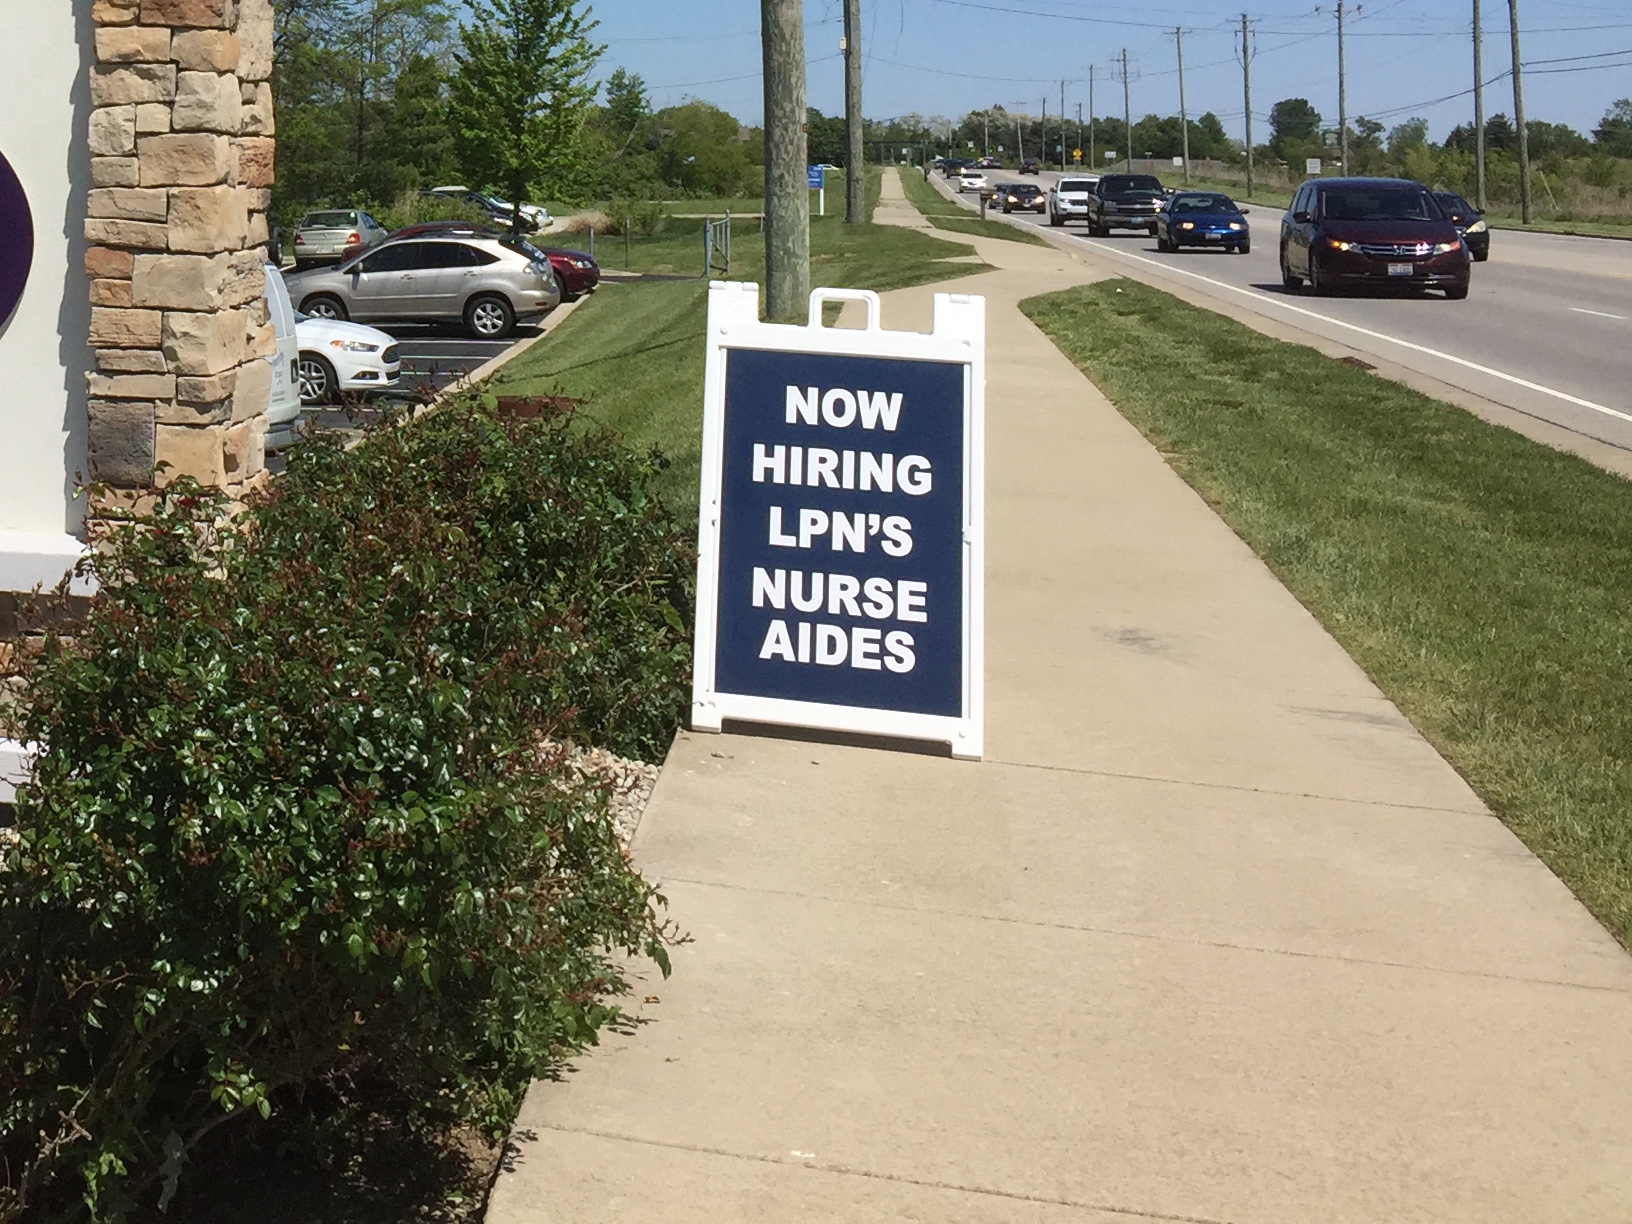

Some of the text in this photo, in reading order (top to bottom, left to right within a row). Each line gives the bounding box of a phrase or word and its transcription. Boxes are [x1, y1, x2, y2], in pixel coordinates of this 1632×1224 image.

[785, 385, 904, 431] NOW
[751, 442, 933, 496] HIRING
[768, 505, 913, 557] LPN'S
[751, 566, 928, 623] NURSE
[758, 619, 916, 674] AIDES
